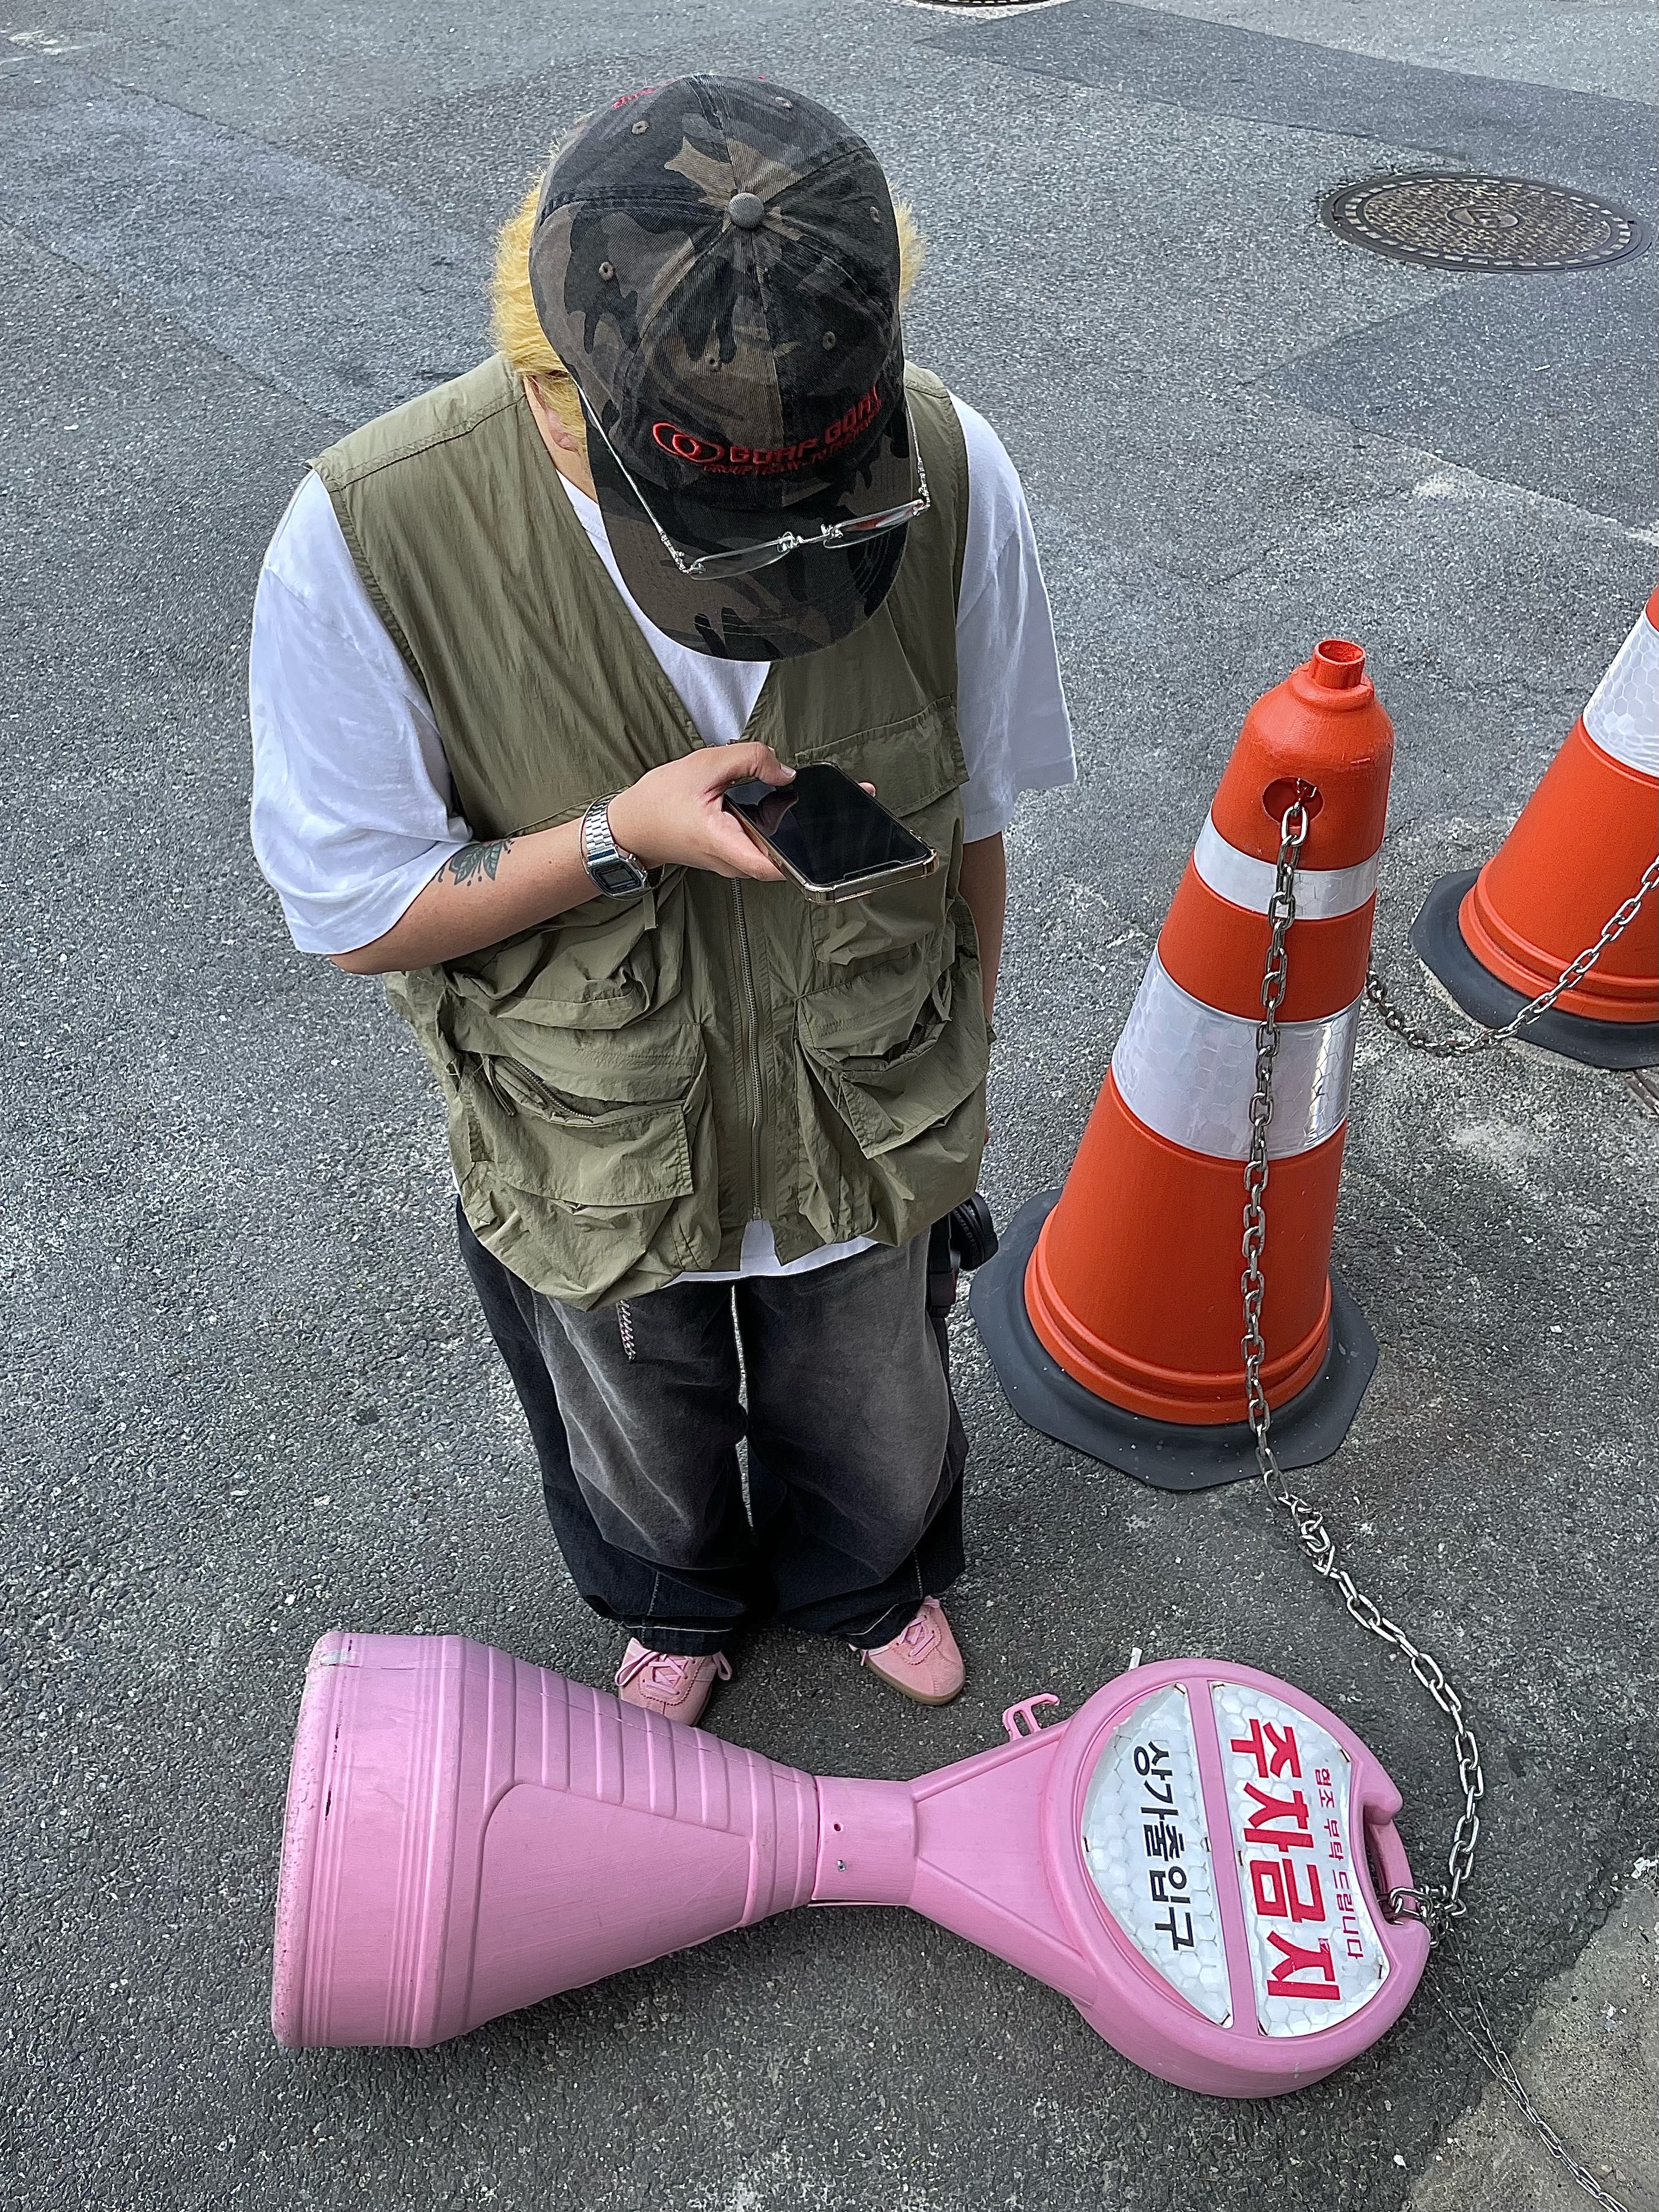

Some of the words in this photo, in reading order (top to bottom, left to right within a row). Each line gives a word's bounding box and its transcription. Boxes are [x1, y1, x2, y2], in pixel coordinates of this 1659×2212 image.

[1315, 1767, 1335, 1809] 협조
[1133, 1740, 1195, 1951] 상가출입구
[1230, 1718, 1341, 2000] 주차금지
[1323, 1818, 1344, 1860] 부탁
[1332, 1870, 1364, 1959] 드립니다
